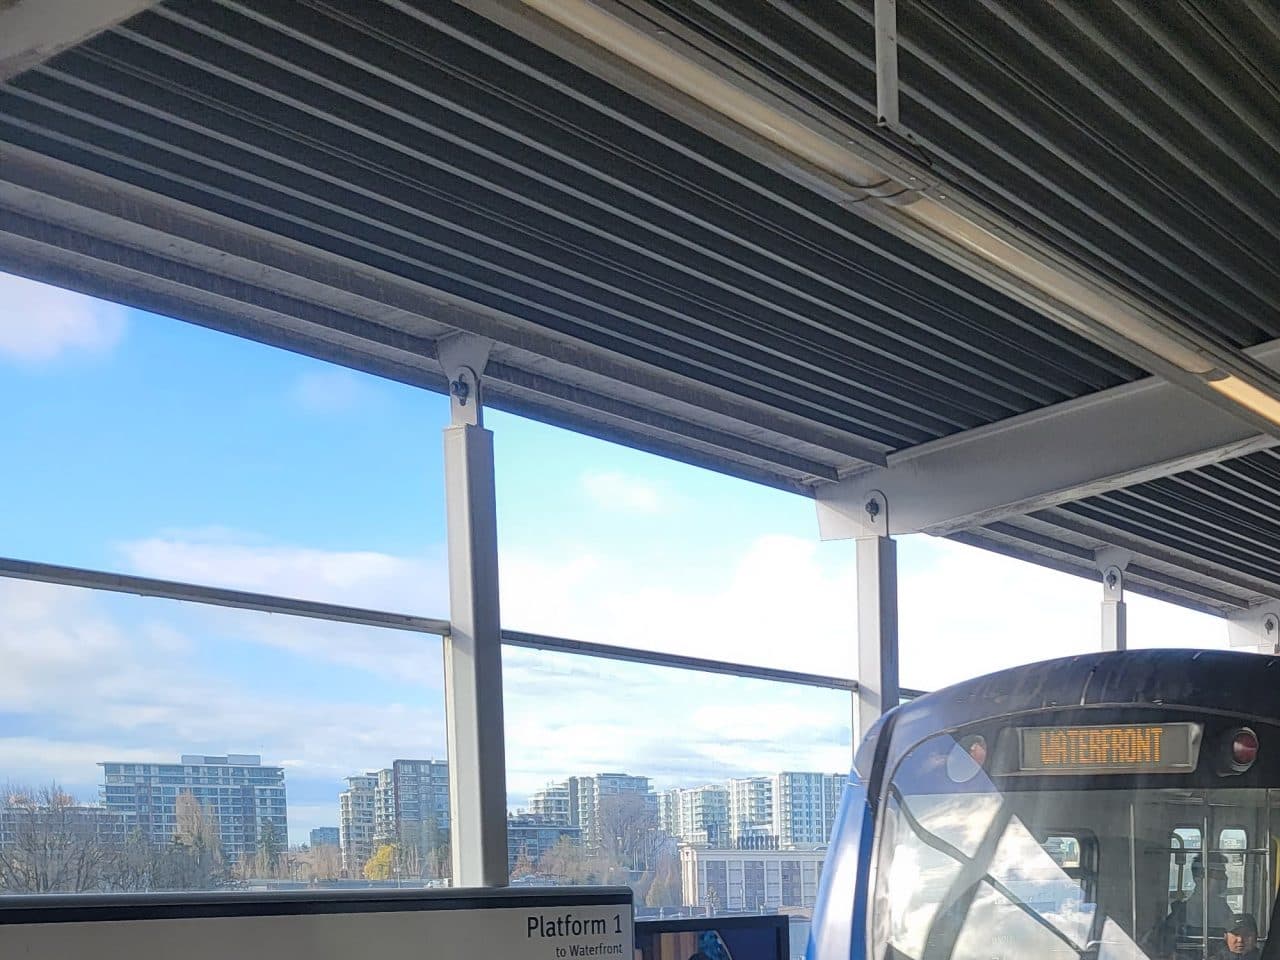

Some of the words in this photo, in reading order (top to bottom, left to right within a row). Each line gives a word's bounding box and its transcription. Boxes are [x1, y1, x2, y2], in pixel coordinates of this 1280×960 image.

[1040, 727, 1163, 766] WATERFRONT
[527, 914, 606, 938] Platform
[613, 914, 622, 934] 1
[556, 946, 566, 958] to
[569, 943, 623, 957] Waterfront
